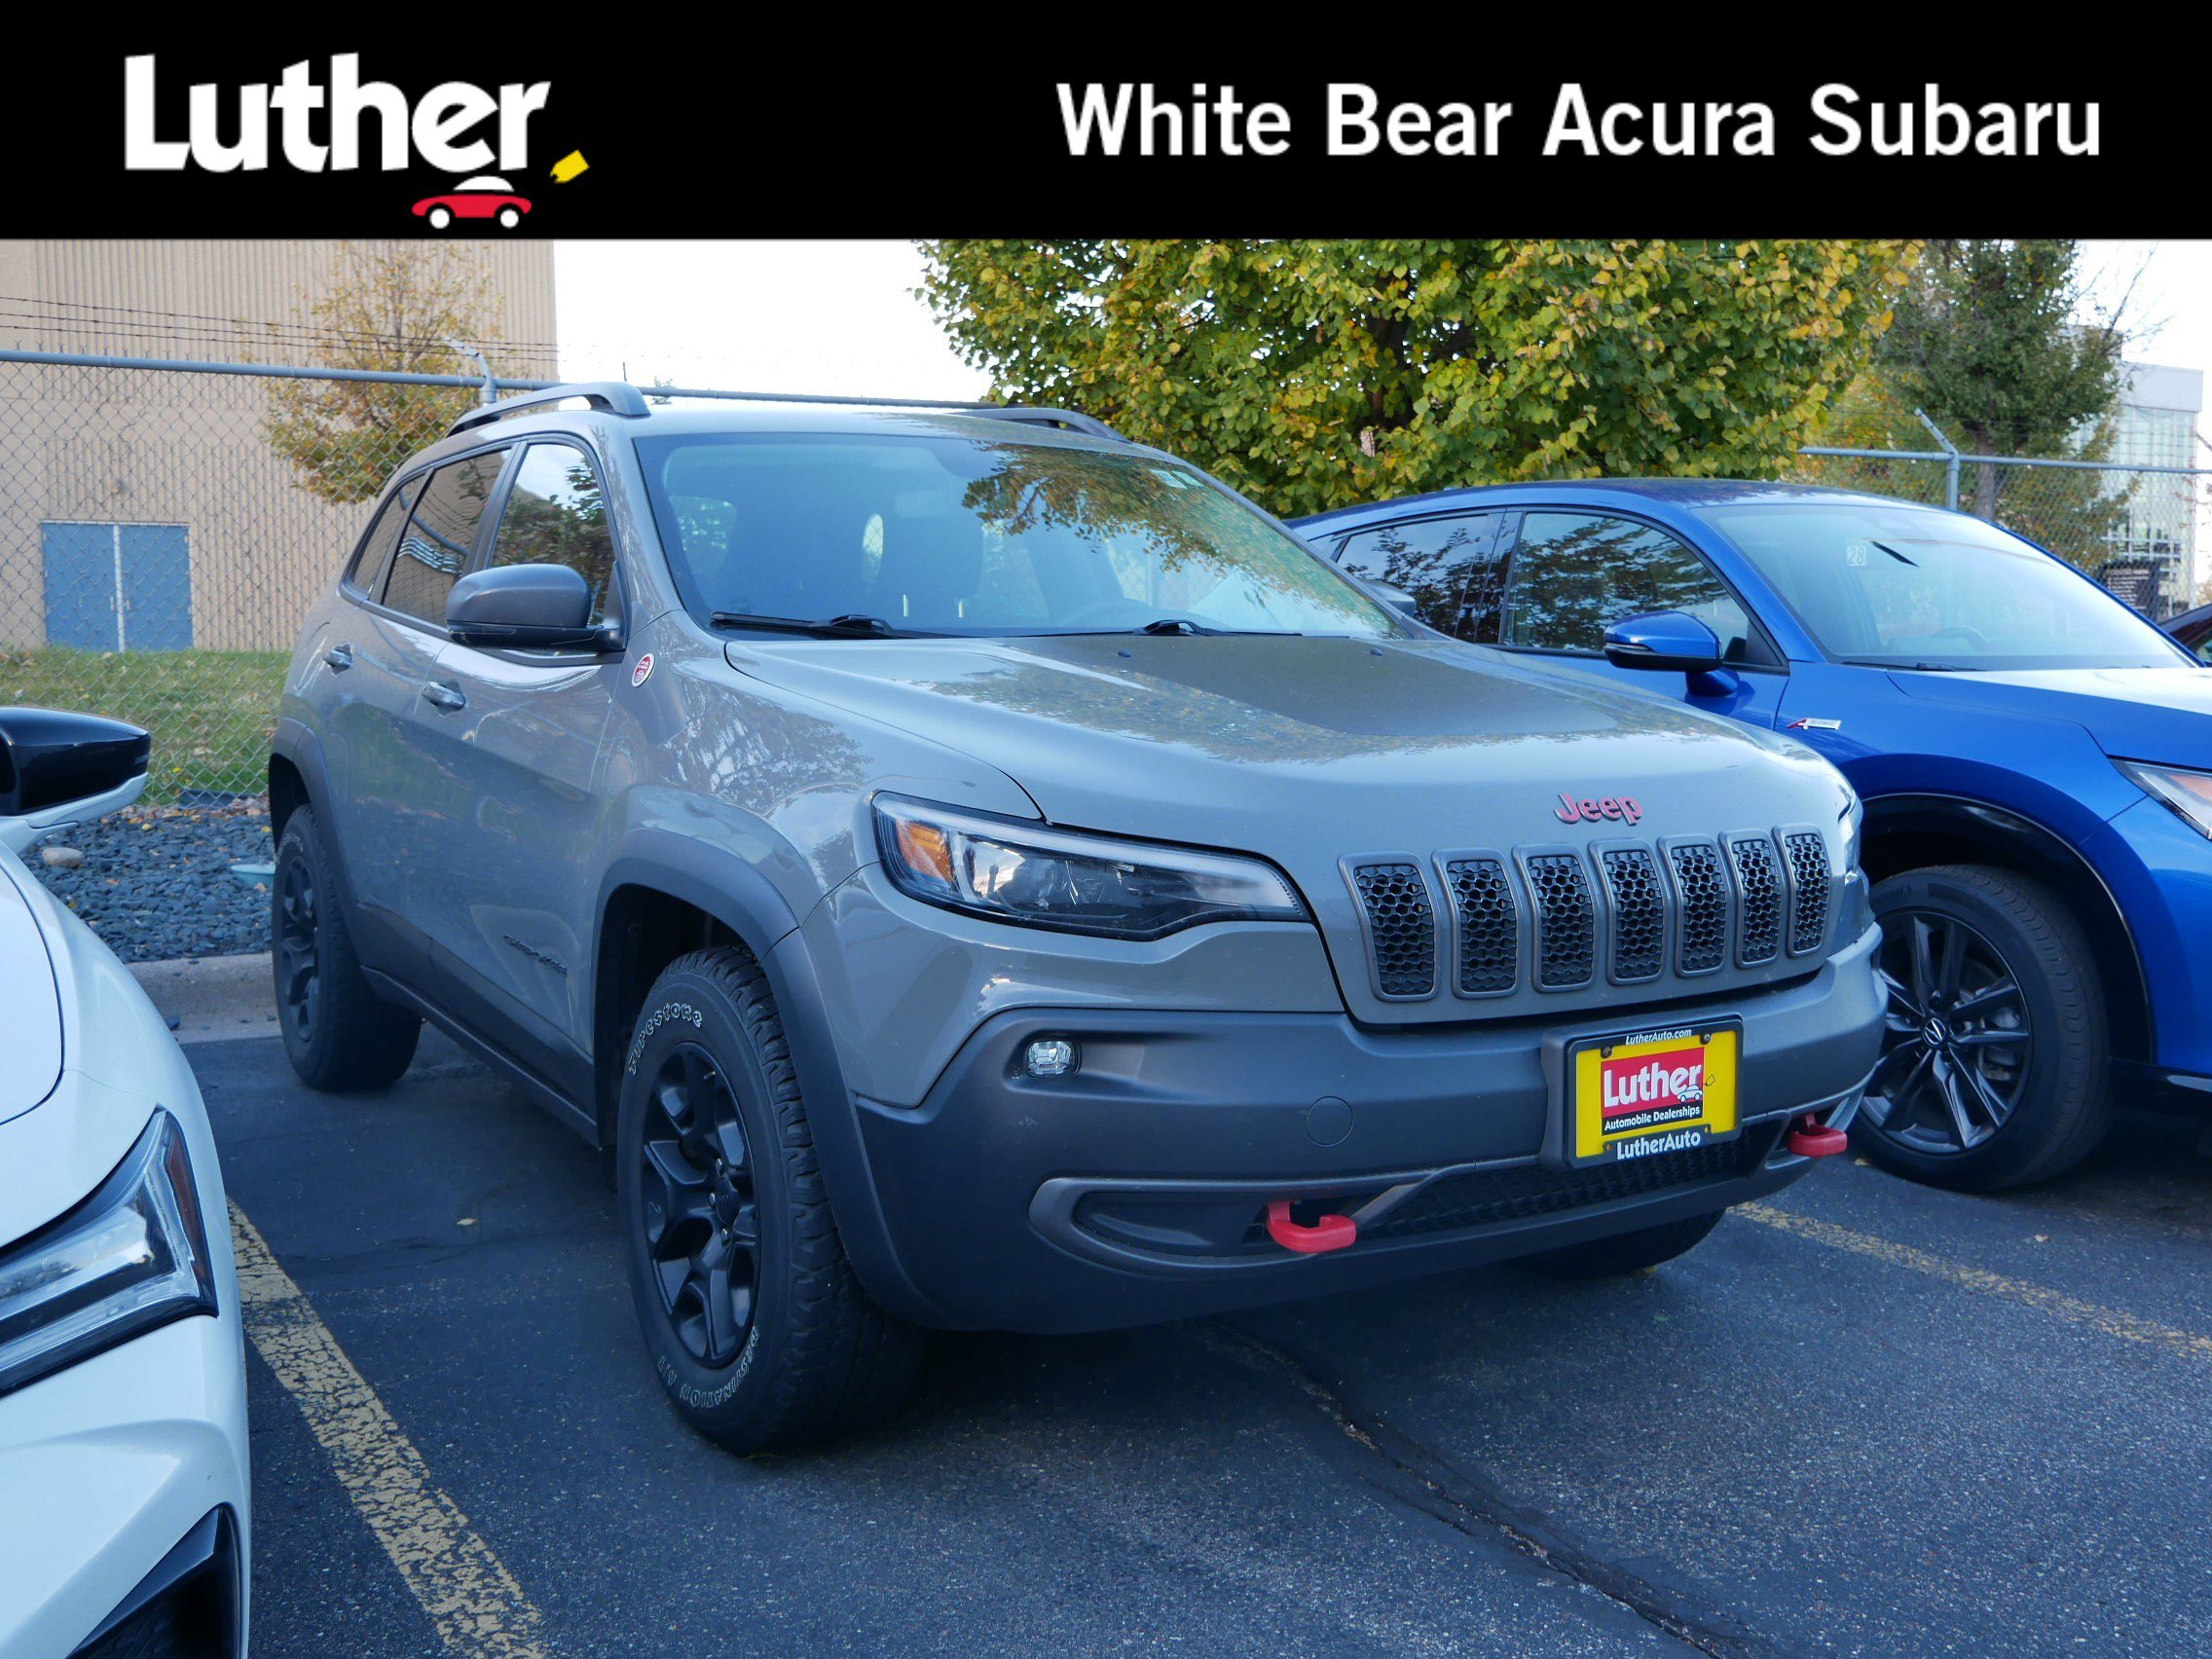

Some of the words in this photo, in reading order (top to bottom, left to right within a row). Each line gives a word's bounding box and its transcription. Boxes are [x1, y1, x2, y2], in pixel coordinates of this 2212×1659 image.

[1848, 547, 1864, 565] 28
[1553, 793, 1643, 827] Jeep
[629, 1003, 702, 1075] Firestone
[1626, 1028, 1692, 1045] LutherAuto.com
[1604, 1061, 1702, 1108] Luther
[1604, 1114, 1652, 1130] Automobile
[1653, 1105, 1701, 1122] Dealerships
[1616, 1129, 1701, 1160] LutherAuto
